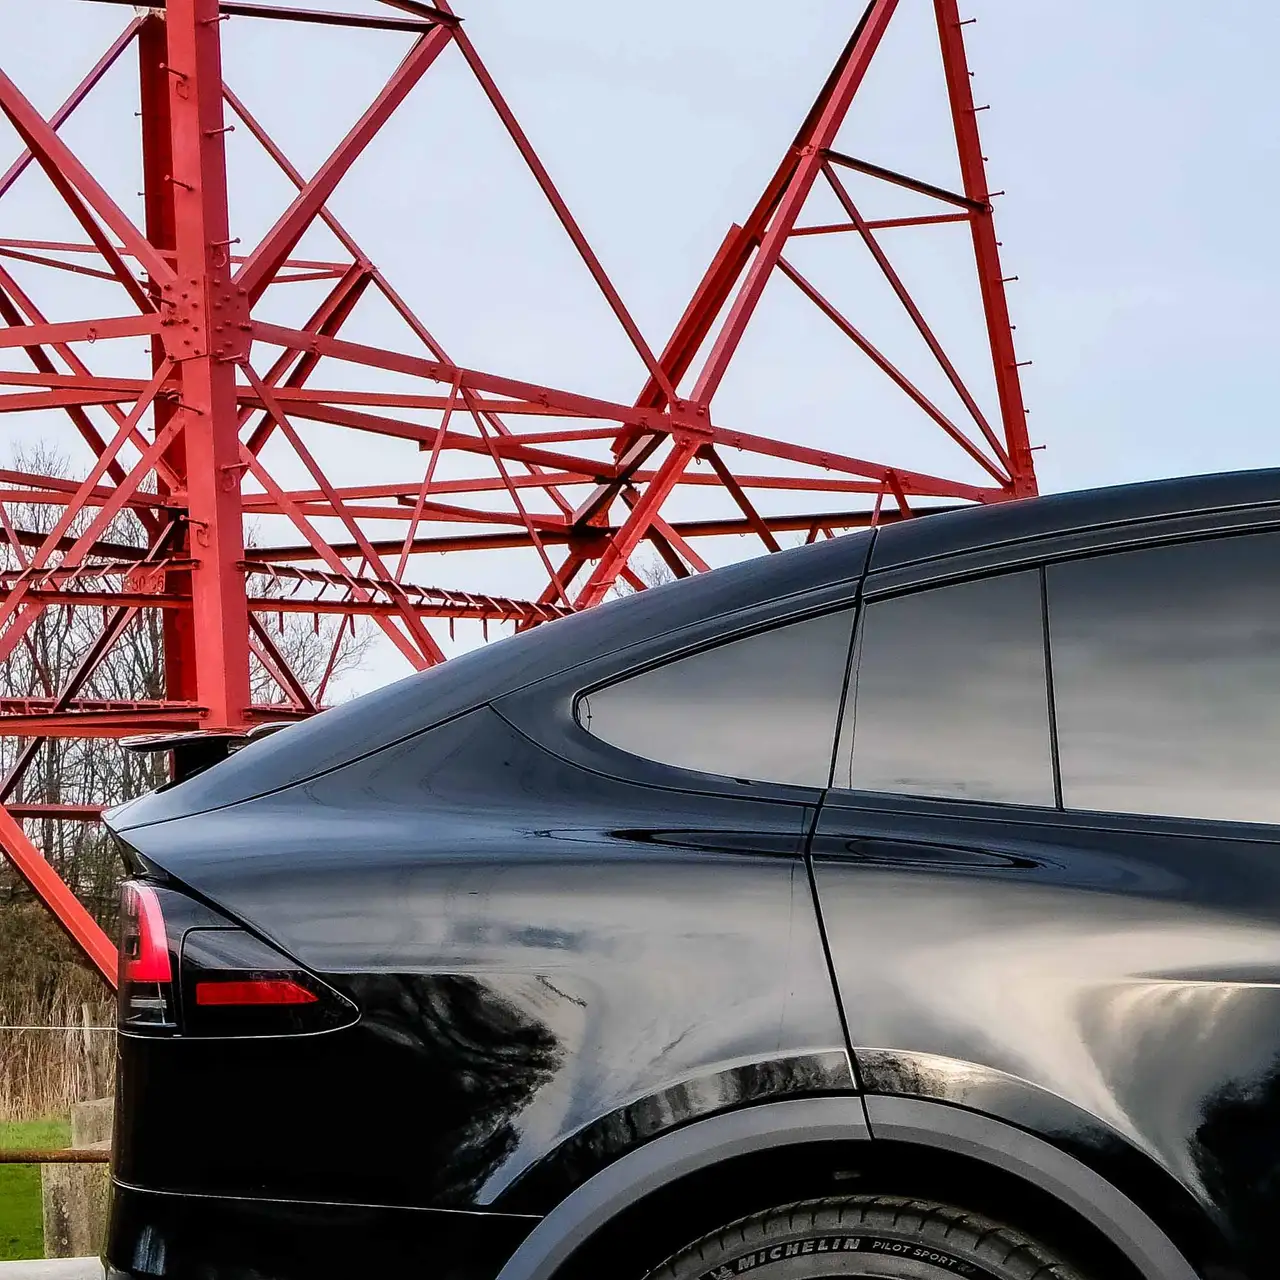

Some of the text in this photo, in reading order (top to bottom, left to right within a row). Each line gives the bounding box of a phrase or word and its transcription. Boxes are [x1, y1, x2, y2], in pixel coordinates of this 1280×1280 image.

[737, 1237, 861, 1271] MICHELIN
[872, 1240, 910, 1254] PILOT
[912, 1248, 957, 1268] SPORT
